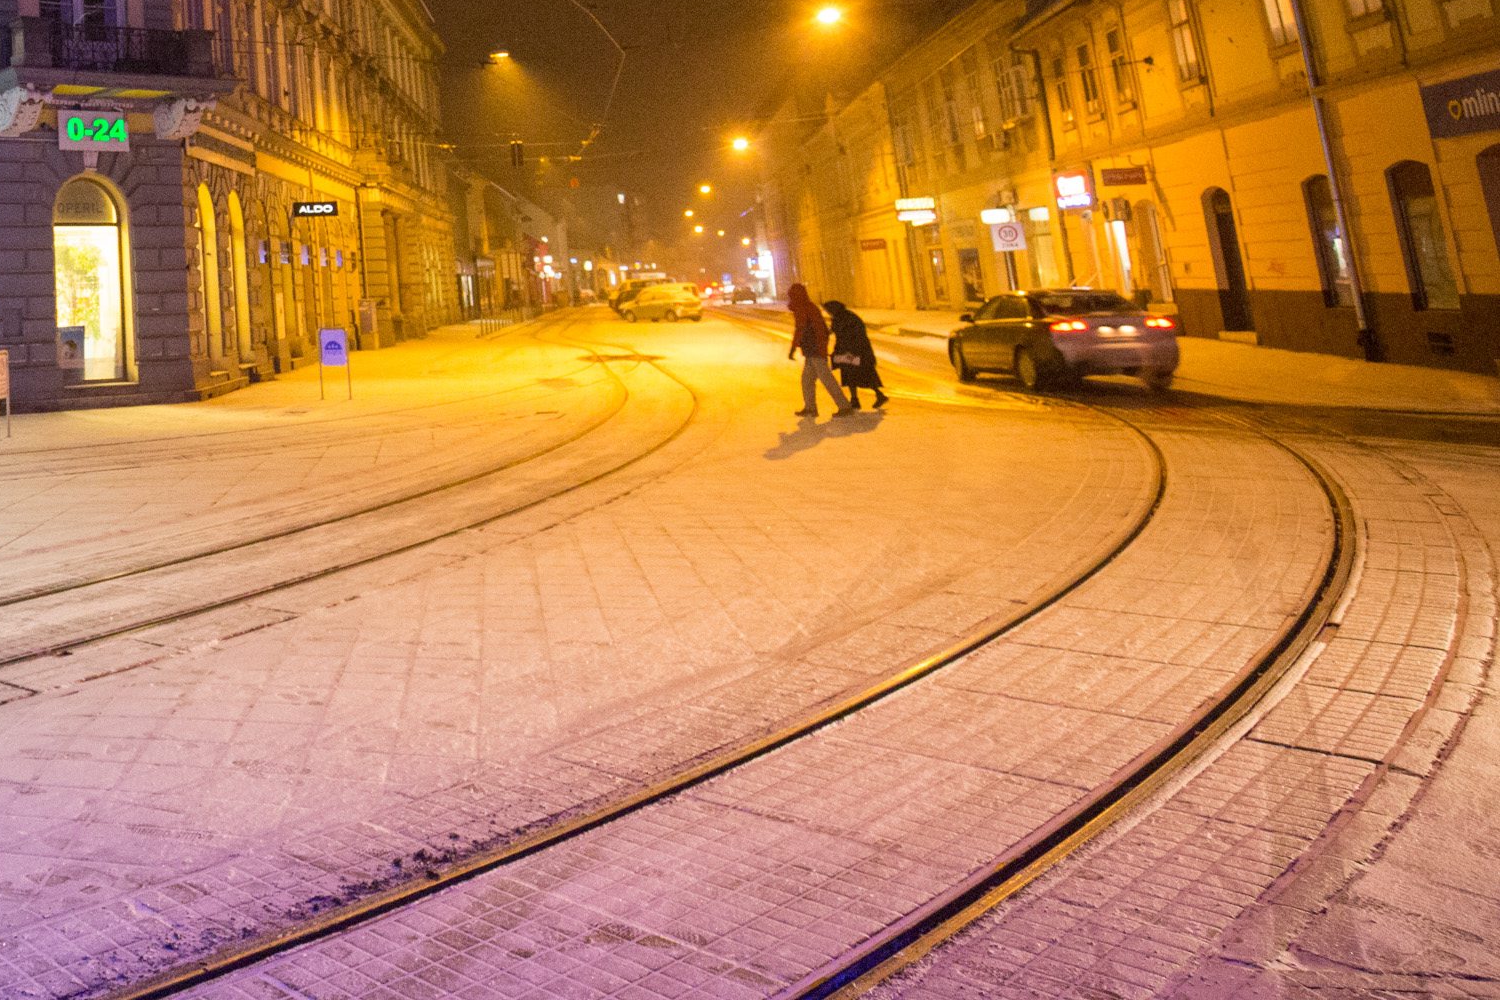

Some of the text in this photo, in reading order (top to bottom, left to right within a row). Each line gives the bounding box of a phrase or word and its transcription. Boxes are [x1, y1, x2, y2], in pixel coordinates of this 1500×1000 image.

[1461, 88, 1500, 118] mlin
[67, 117, 128, 143] 0-24
[298, 204, 334, 214] ALDO
